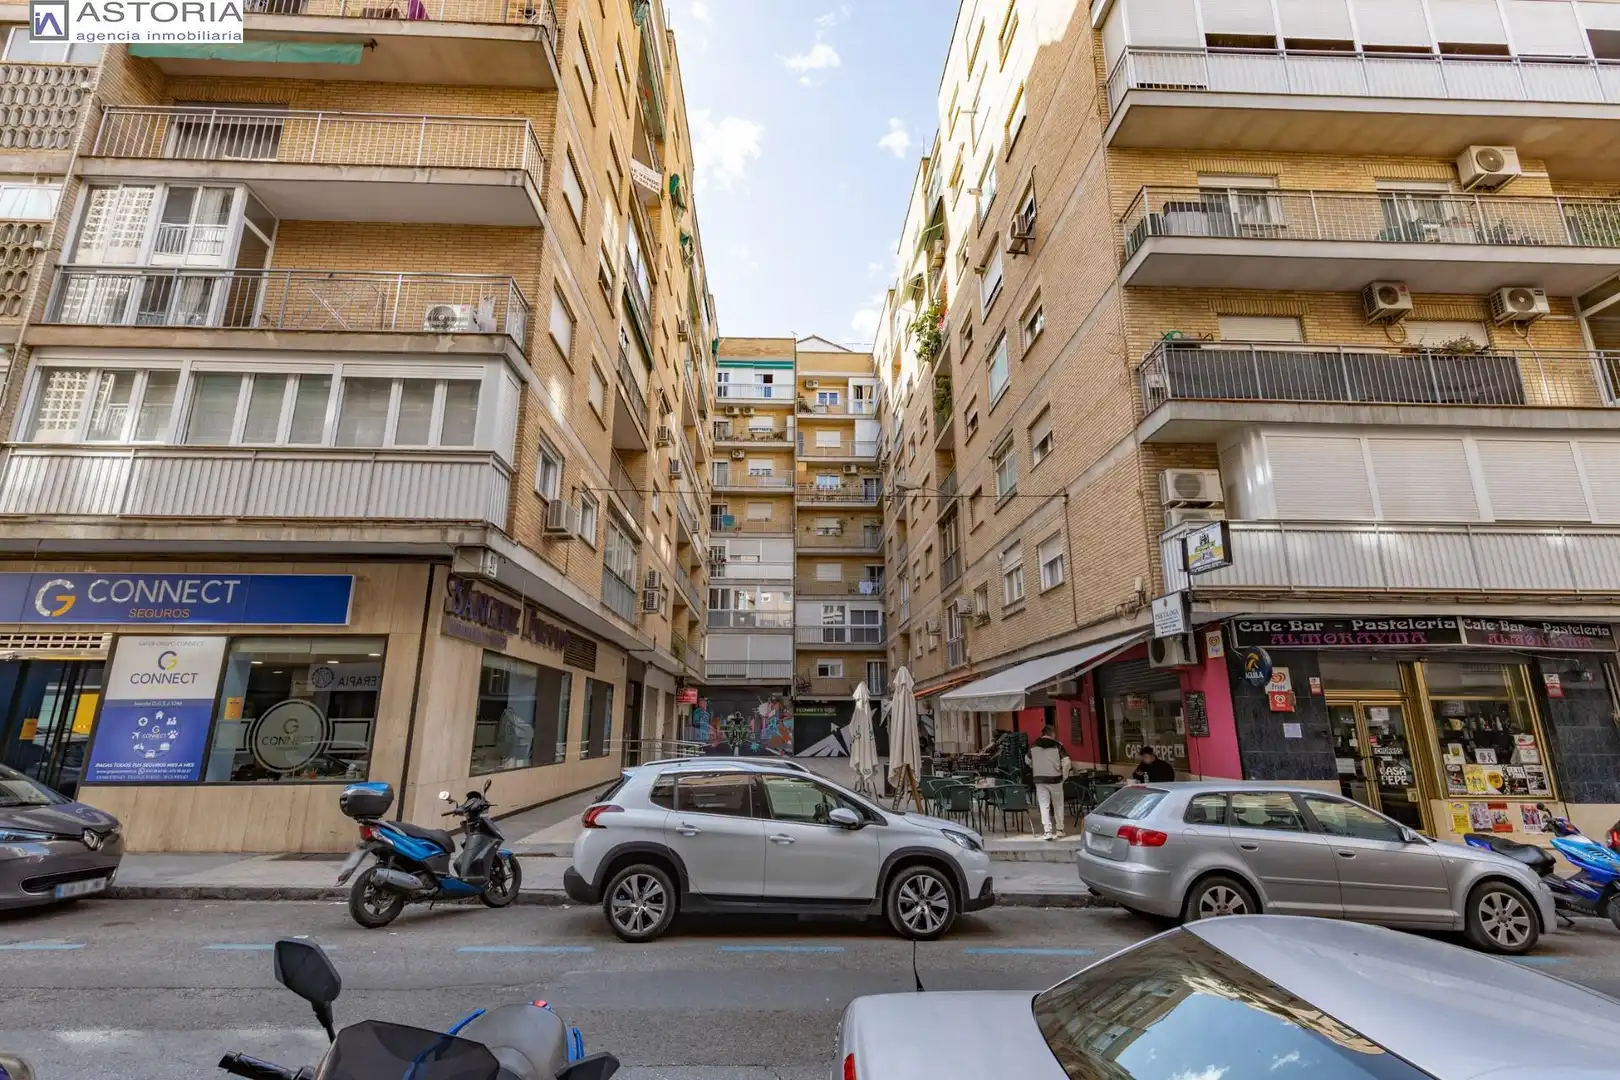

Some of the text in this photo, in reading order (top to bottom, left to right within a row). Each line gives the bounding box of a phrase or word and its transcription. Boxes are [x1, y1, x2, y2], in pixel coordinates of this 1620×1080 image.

[87, 579, 241, 604] CONNECT
[128, 608, 190, 618] SEGUROS
[1351, 618, 1457, 631] Pastelería
[129, 672, 199, 685] CONNECT
[260, 735, 316, 747] CONNECT
